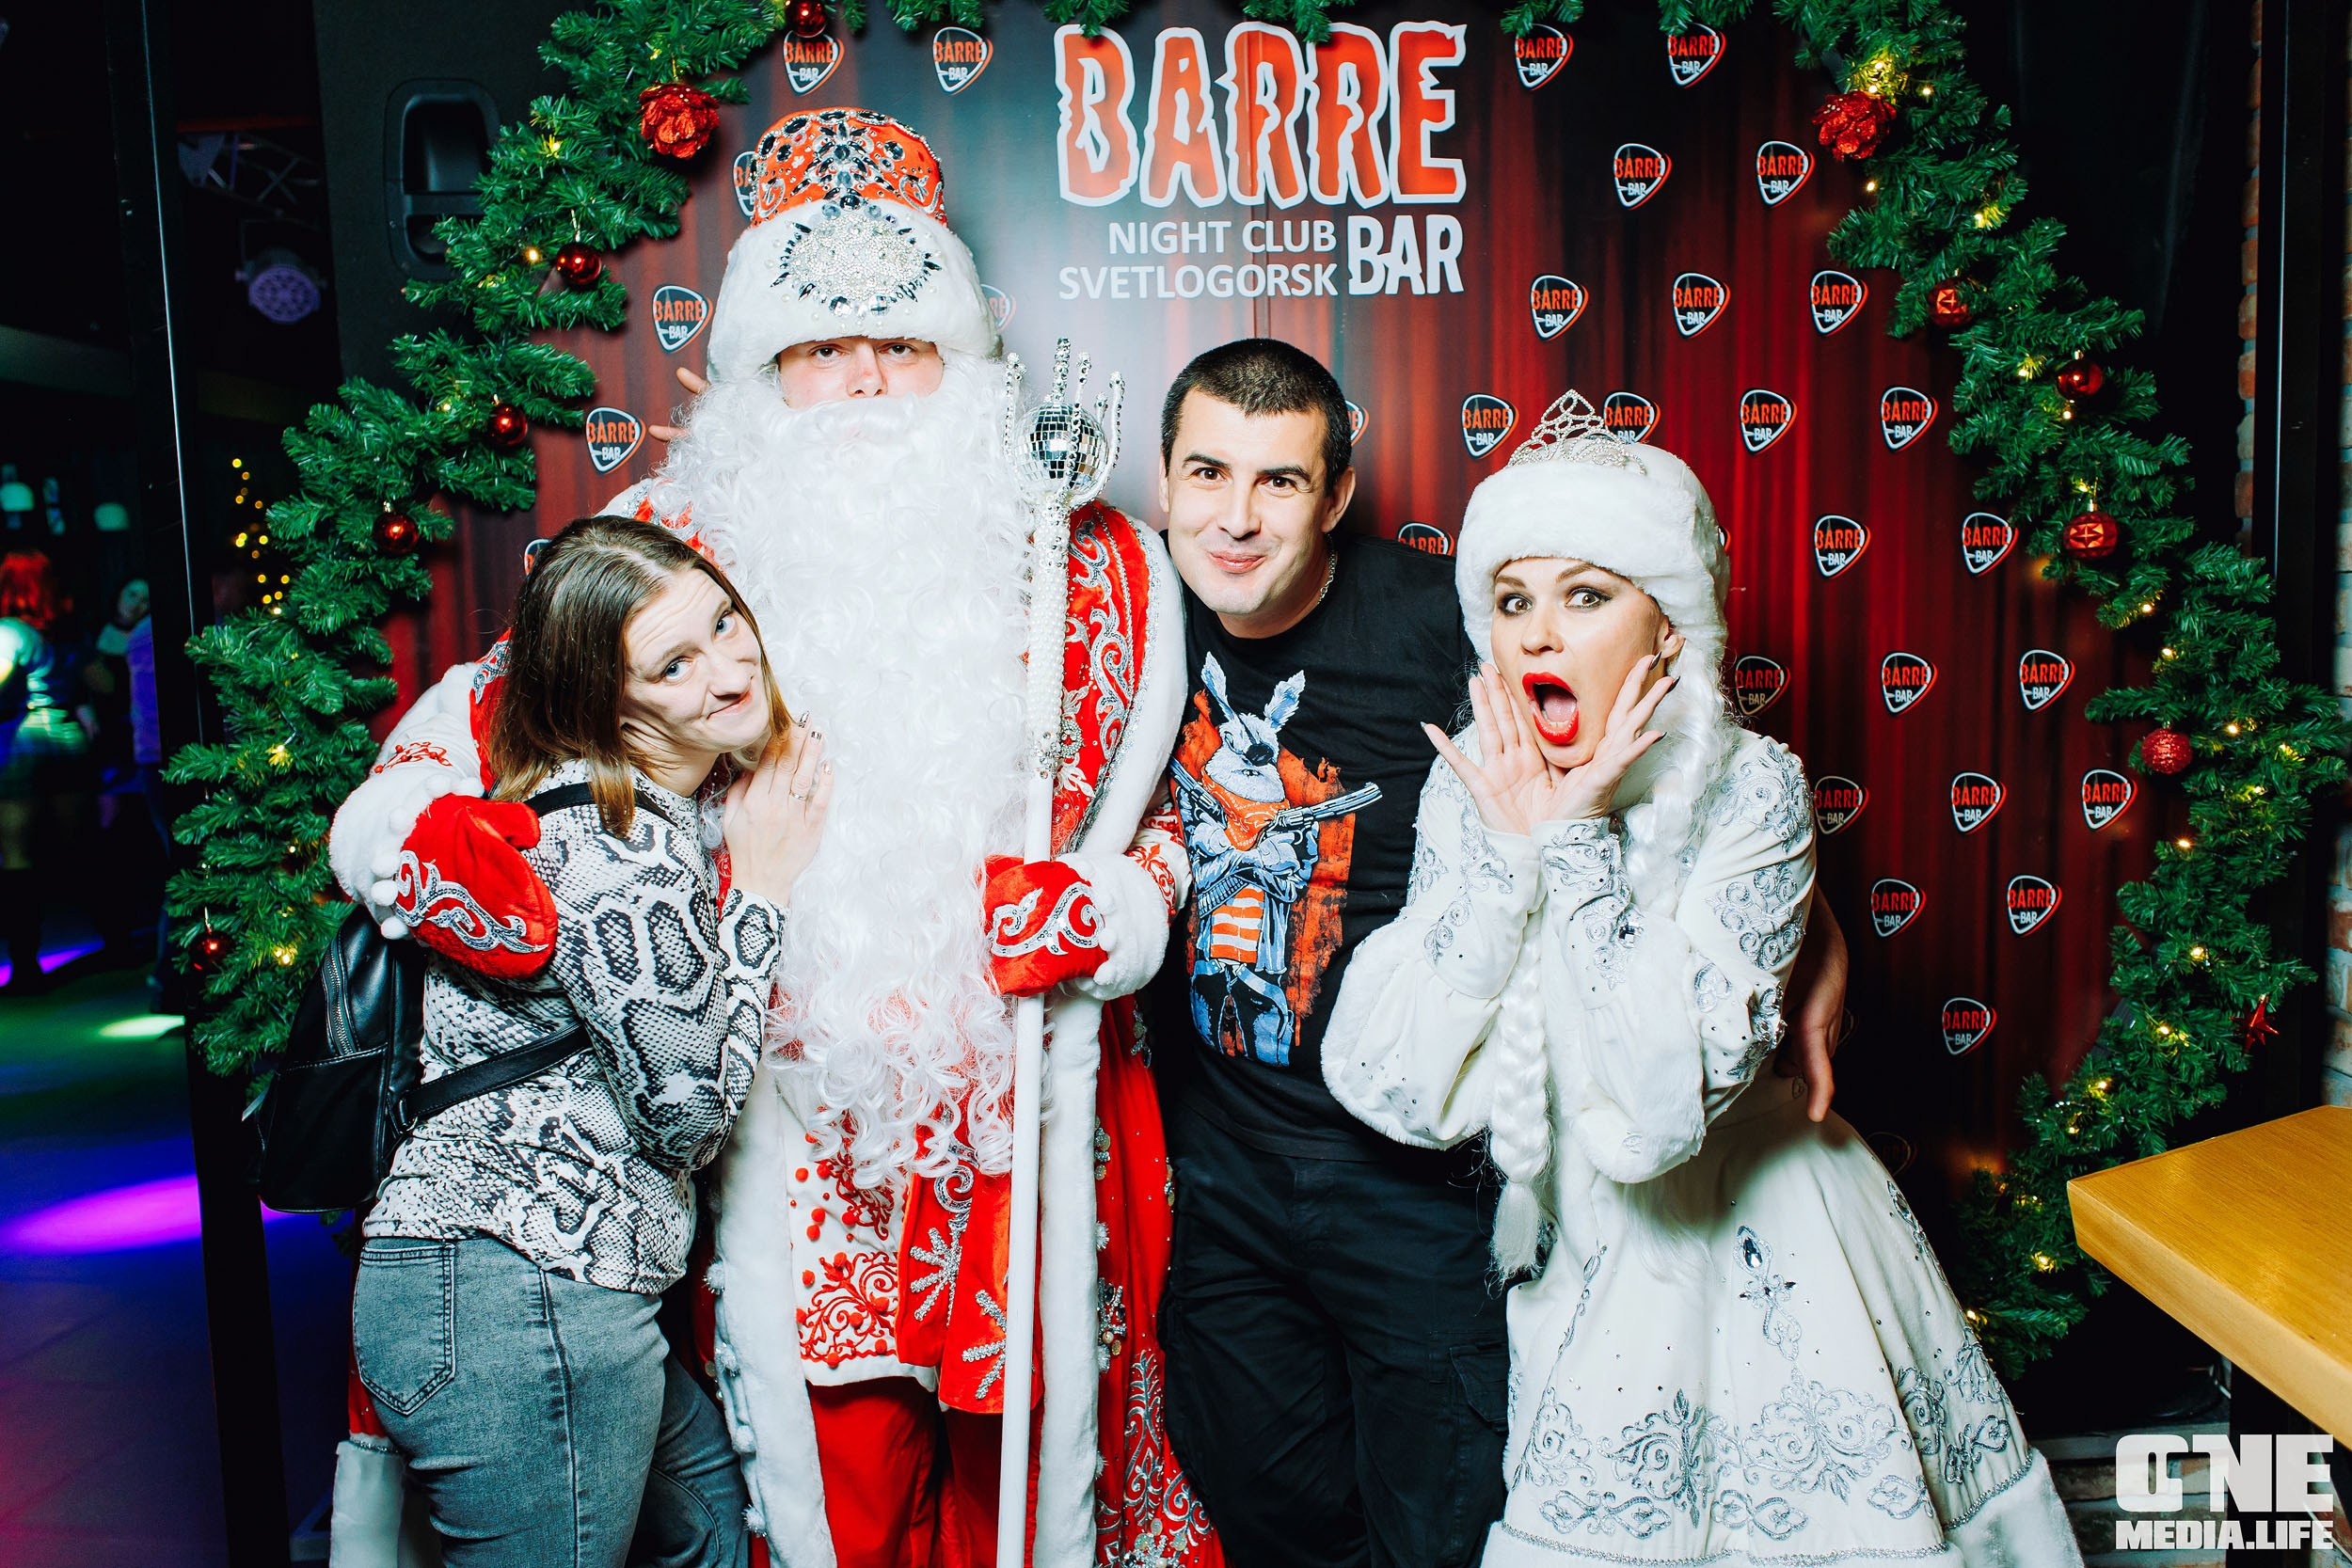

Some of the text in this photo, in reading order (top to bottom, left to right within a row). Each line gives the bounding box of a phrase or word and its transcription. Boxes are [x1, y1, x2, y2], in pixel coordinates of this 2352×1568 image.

[784, 41, 834, 64] BARRE
[933, 41, 985, 64] BARRE
[1516, 38, 1565, 58] BARRE
[1668, 36, 1717, 56] BARRE
[799, 68, 818, 80] BAR
[948, 68, 967, 80] BAR
[1529, 63, 1548, 76] BAR
[1682, 60, 1700, 74] BAR
[1054, 21, 1467, 209] BARRE
[1614, 157, 1662, 179] BARRE
[1757, 155, 1805, 176] BARRE
[1628, 182, 1646, 196] BAR
[1771, 180, 1789, 193] BAR
[1108, 220, 1337, 254] NIGHT CLUB
[1347, 214, 1464, 294] BAR
[1058, 263, 1339, 300] SVETLOGORSK
[1532, 288, 1580, 309] BARRE
[1674, 286, 1722, 308] BARRE
[1812, 284, 1859, 305] BARRE
[655, 300, 703, 322] BARRE
[1545, 313, 1564, 327] BAR
[1687, 311, 1706, 325] BAR
[1824, 309, 1843, 323] BAR
[669, 325, 688, 339] BAR
[1462, 408, 1511, 429] BARRE
[1605, 406, 1651, 426] BARRE
[1740, 404, 1789, 425] BARRE
[1883, 401, 1930, 422] BARRE
[587, 422, 636, 442] BARRE
[1476, 433, 1494, 446] BAR
[1756, 428, 1773, 442] BAR
[1895, 425, 1914, 439] BAR
[602, 448, 621, 461] BAR
[1399, 537, 1445, 554] ARRE
[1815, 528, 1862, 547] BARRE
[1963, 526, 2010, 546] BARRE
[1828, 553, 1846, 566] BAR
[1975, 550, 1993, 563] BAR
[1736, 669, 1781, 689] BARRE
[1883, 666, 1930, 687] BARRE
[2020, 663, 2067, 684] BARRE
[1749, 693, 1766, 705] BAR
[1895, 689, 1913, 703] BAR
[2032, 687, 2050, 700] BAR
[1815, 789, 1859, 808] BARRE
[1952, 785, 1998, 806] BARRE
[2083, 782, 2130, 803] BARRE
[1827, 813, 1844, 824] BAR
[1964, 809, 1981, 822] BAR
[2095, 805, 2112, 818] BAR
[1872, 893, 1917, 912] BARRE
[2008, 888, 2055, 909] BARRE
[1884, 914, 1901, 927] BAR
[2021, 911, 2037, 924] BAR
[1943, 1011, 1989, 1031] BARRE
[1955, 1033, 1972, 1046] BAR
